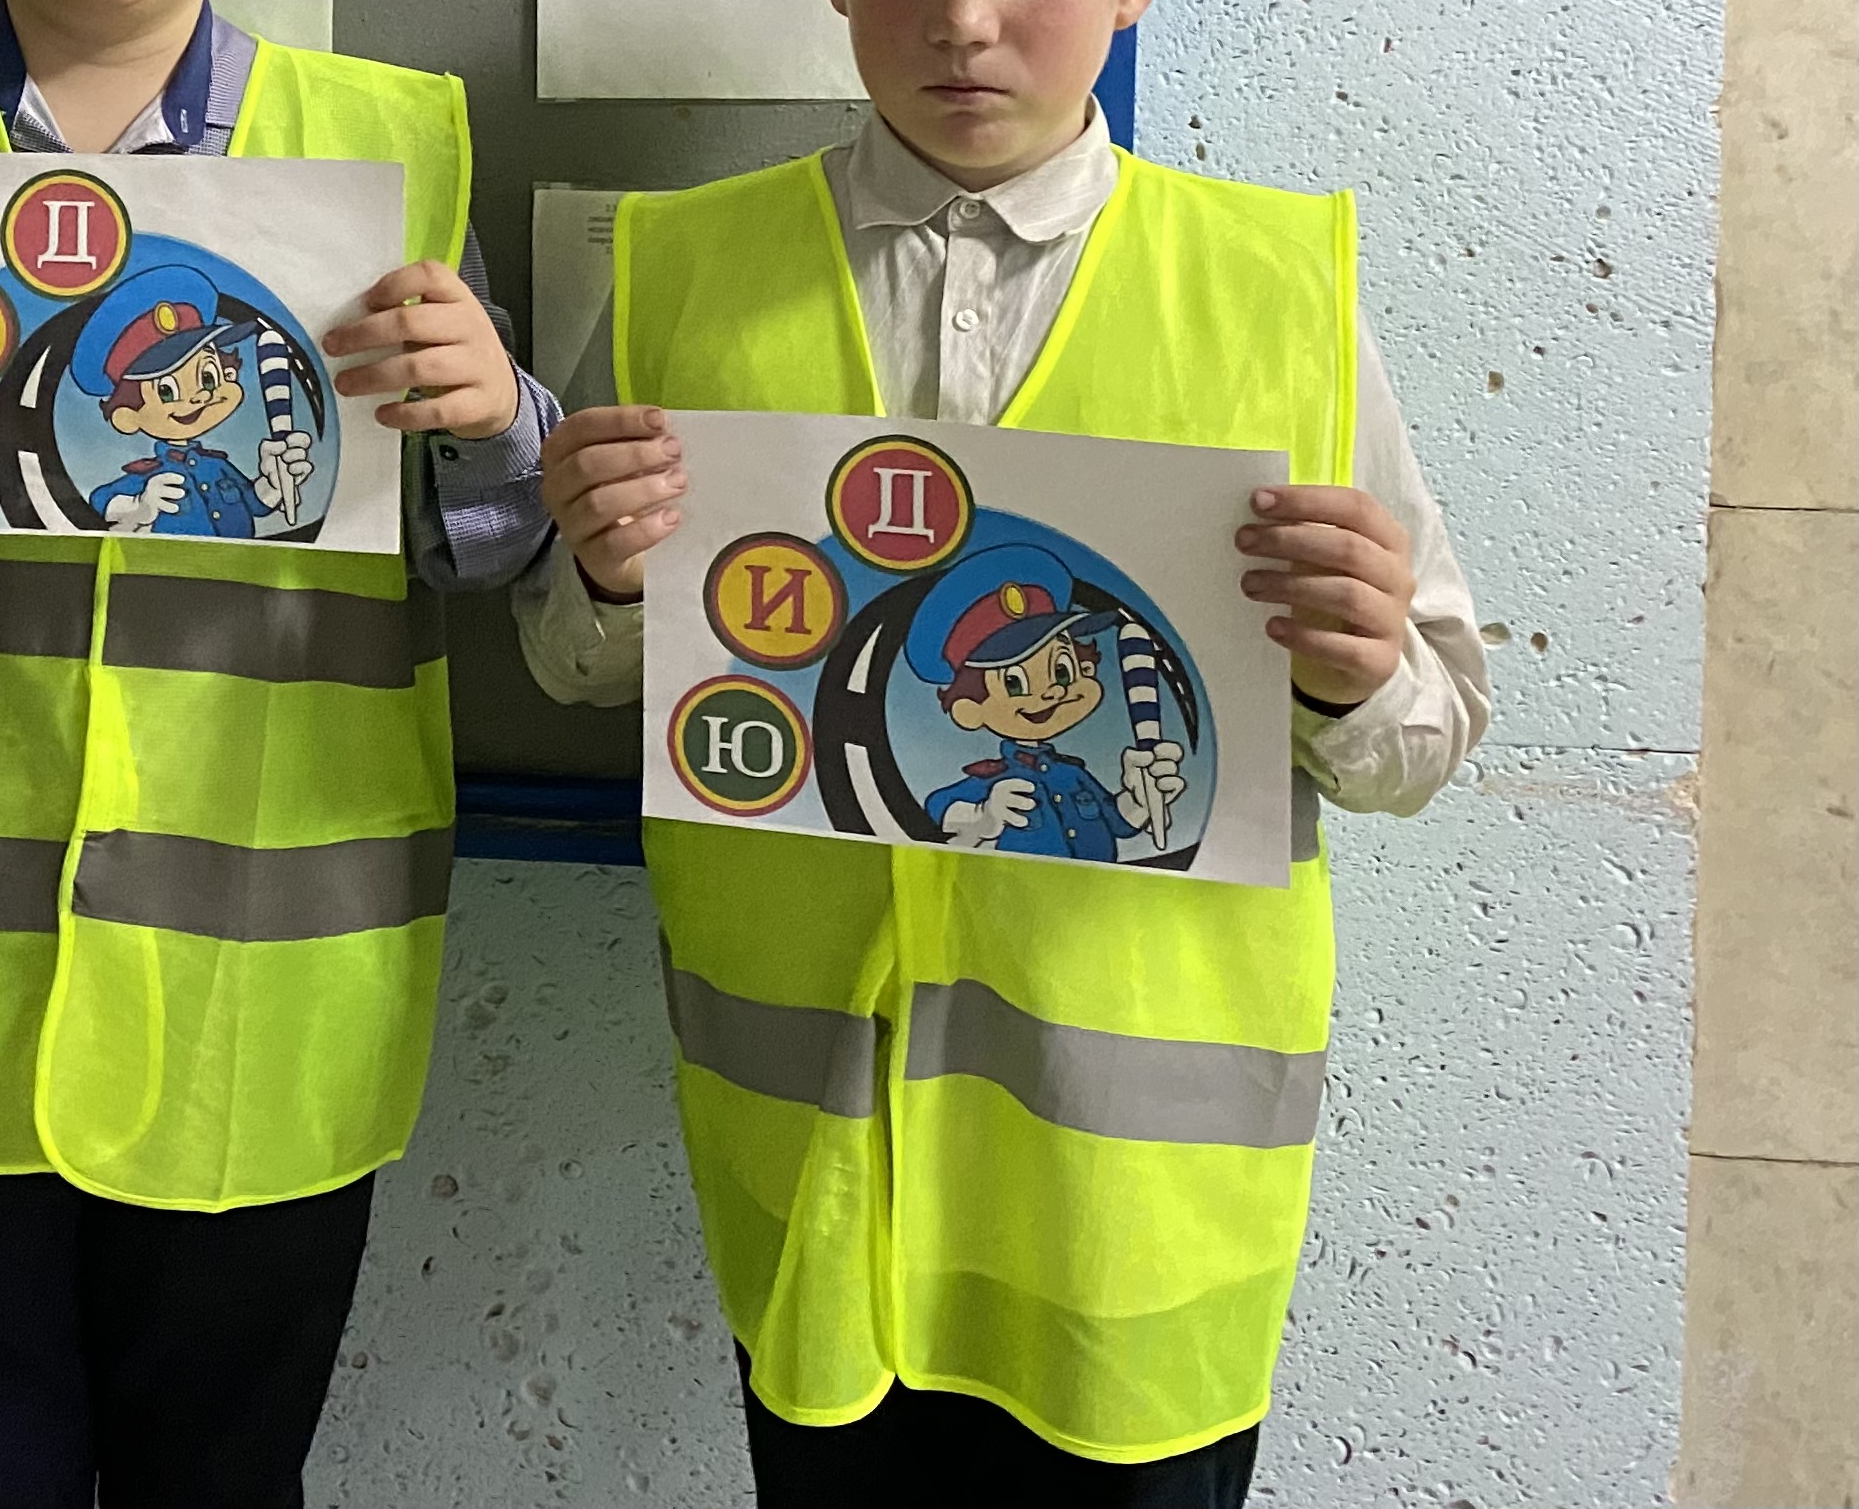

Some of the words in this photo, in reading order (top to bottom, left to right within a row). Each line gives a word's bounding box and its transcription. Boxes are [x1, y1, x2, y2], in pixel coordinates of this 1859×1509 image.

[37, 199, 97, 270] Д
[867, 466, 935, 544] Д
[744, 564, 813, 636] И
[700, 714, 784, 779] Ю
